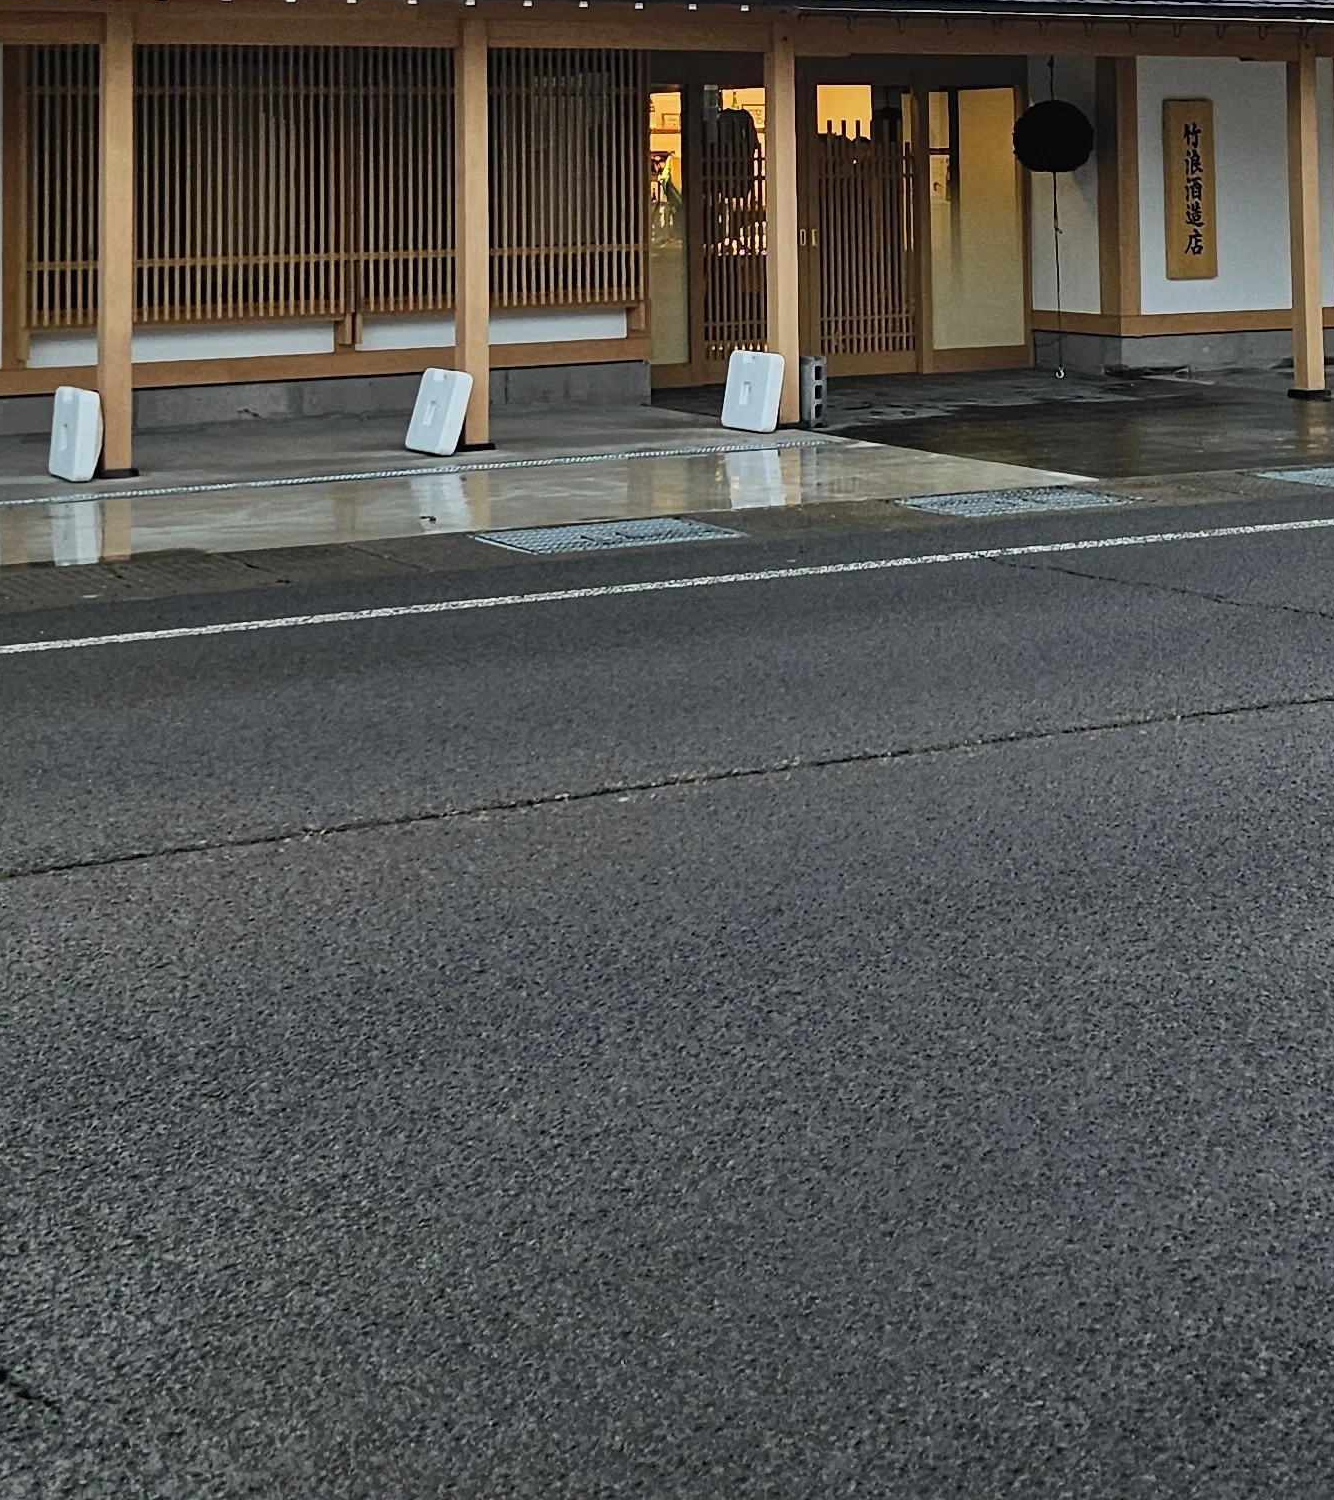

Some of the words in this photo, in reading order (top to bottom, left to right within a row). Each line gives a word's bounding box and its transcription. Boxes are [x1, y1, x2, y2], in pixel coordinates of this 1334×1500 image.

[1183, 122, 1205, 256] 竹浪酒造店
